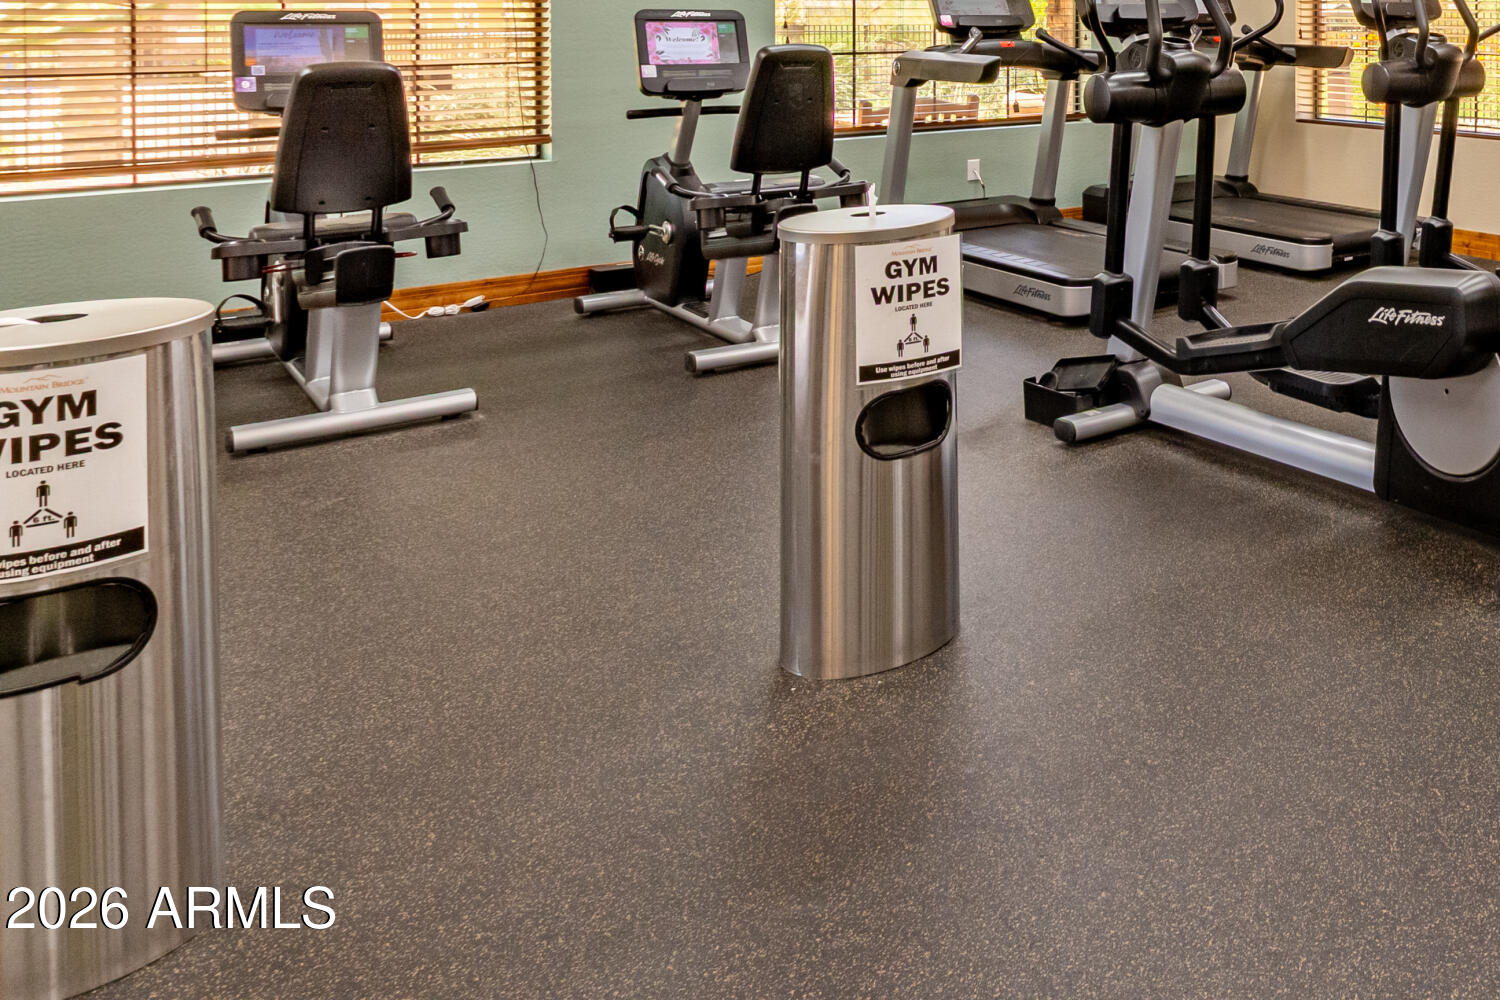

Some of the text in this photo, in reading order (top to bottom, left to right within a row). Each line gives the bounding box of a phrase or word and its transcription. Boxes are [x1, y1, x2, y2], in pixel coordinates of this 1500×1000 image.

[884, 255, 938, 280] GYM
[870, 277, 950, 306] WIPES
[894, 303, 919, 313] LOCATED
[1367, 306, 1446, 326] Life Fitness
[875, 366, 888, 374] Use
[888, 364, 907, 373] wipes
[906, 360, 926, 370] before
[926, 357, 937, 366] and
[0, 389, 97, 429] GYM
[6, 459, 86, 479] LOCATED HERE
[29, 550, 68, 565] before
[70, 544, 92, 558] and
[94, 537, 122, 551] after
[31, 553, 95, 573] equipment
